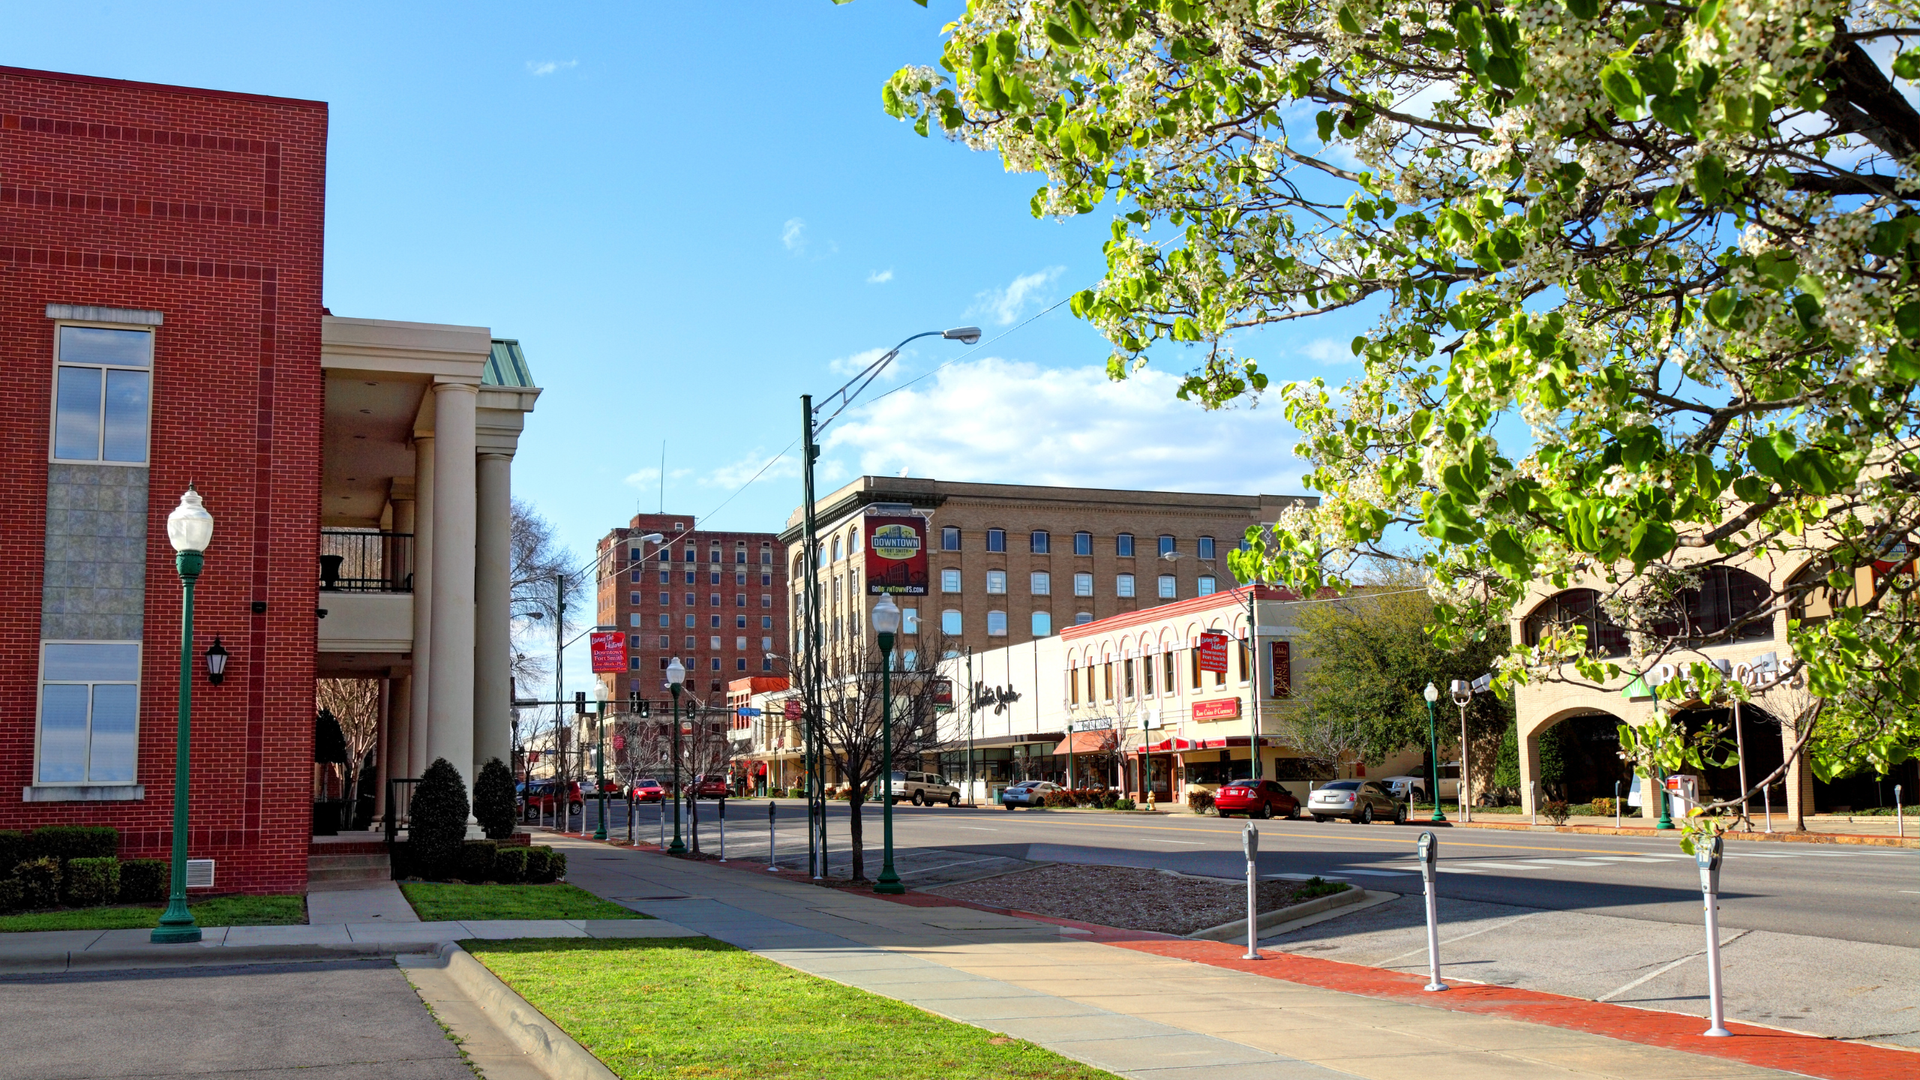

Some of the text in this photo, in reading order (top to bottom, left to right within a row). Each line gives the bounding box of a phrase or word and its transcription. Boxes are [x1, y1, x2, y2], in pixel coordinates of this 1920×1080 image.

[874, 538, 918, 547] DOWNTOWN
[1202, 648, 1226, 656] Downtown
[1658, 656, 1795, 692] REONS
